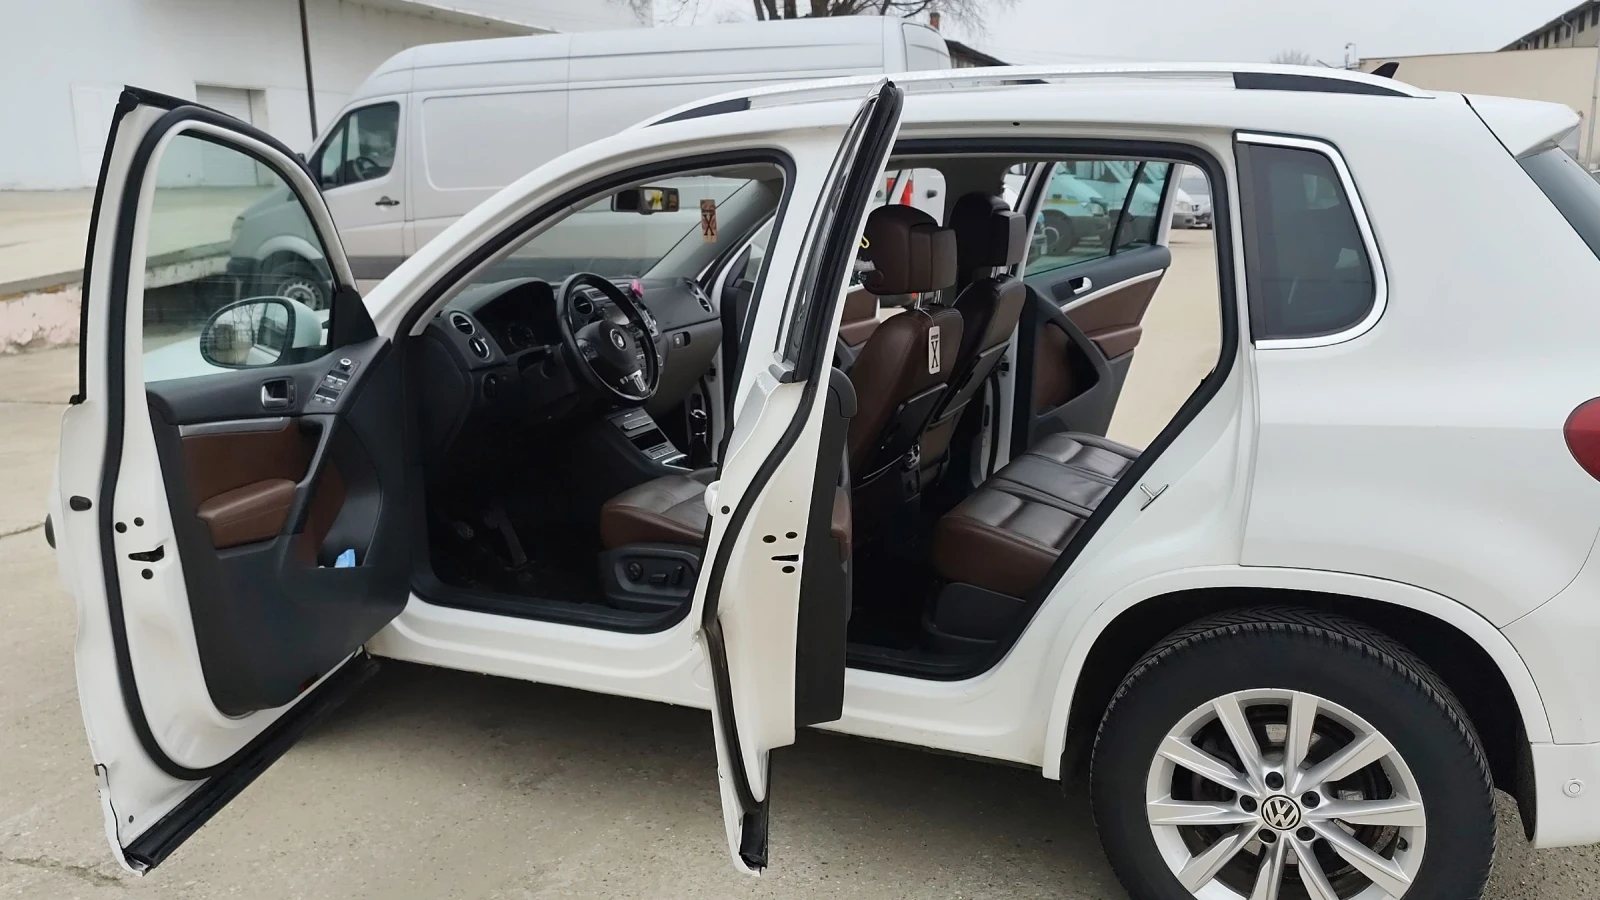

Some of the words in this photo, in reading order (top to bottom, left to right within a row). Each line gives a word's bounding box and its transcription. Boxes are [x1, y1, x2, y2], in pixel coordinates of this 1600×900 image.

[702, 214, 715, 236] X
[930, 340, 939, 369] X
[1263, 797, 1299, 829] VW
